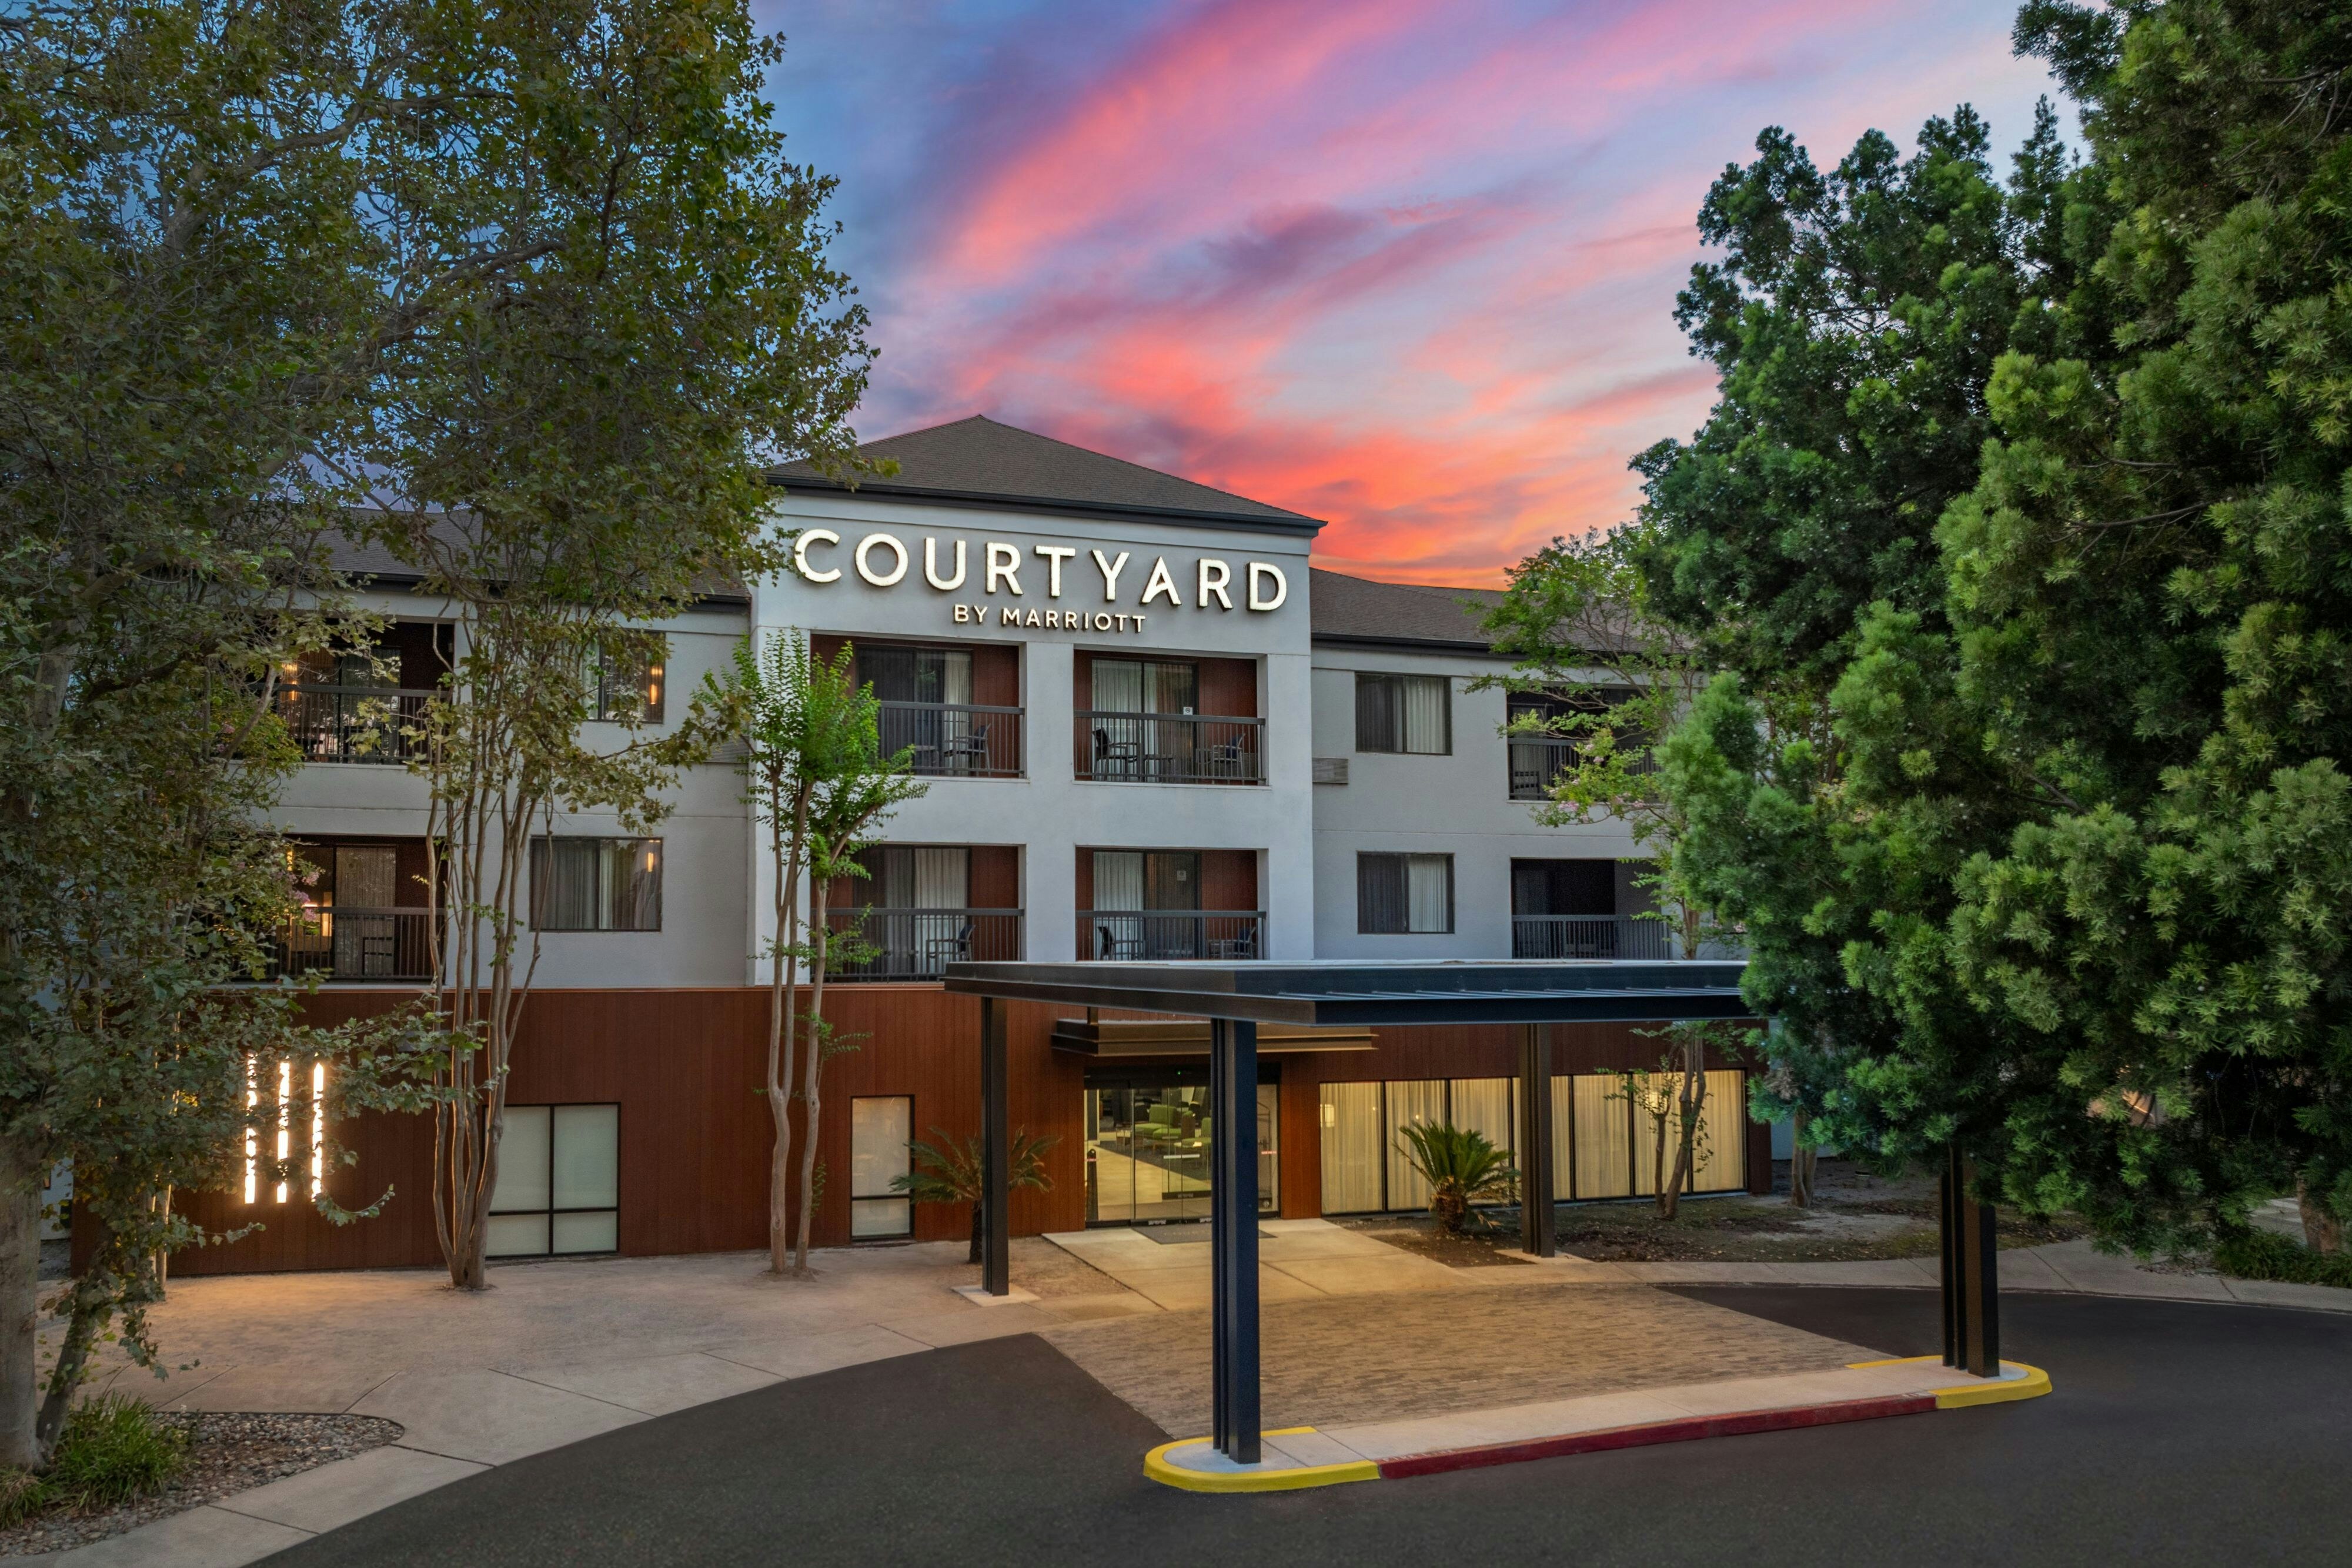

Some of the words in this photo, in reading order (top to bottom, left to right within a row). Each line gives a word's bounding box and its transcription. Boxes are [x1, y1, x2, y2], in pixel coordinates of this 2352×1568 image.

[794, 529, 1288, 611] COURTYARD
[953, 604, 988, 623] BY
[1001, 607, 1147, 633] MARRIOTT
